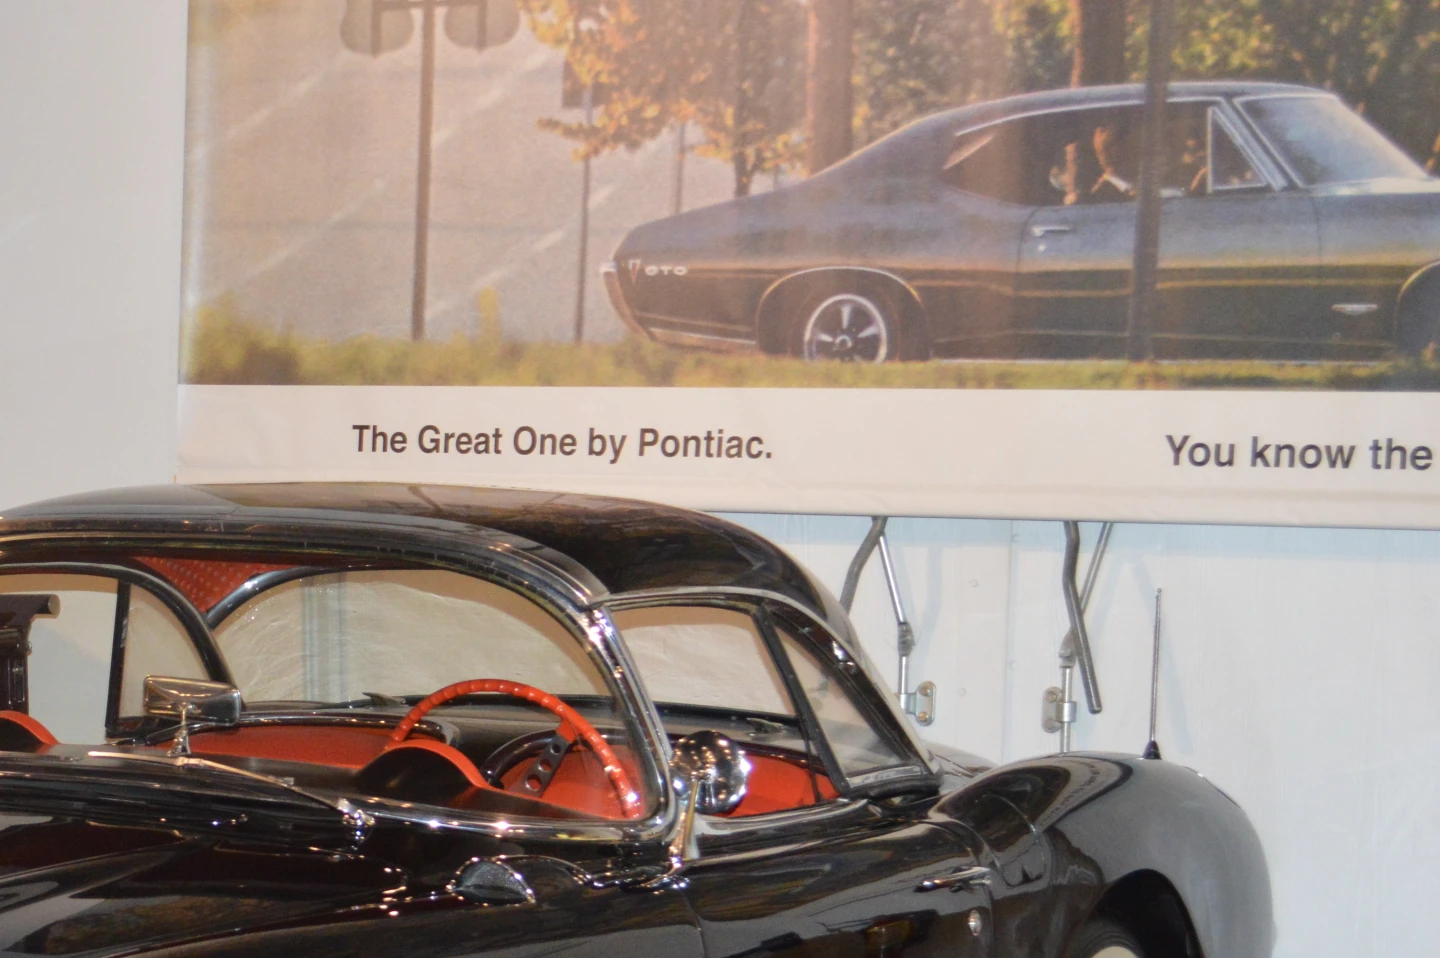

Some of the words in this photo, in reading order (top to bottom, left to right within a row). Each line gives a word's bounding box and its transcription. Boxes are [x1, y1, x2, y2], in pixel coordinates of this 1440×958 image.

[352, 424, 408, 453] The
[418, 424, 503, 455] Great
[513, 425, 577, 456] One
[588, 427, 627, 464] by
[638, 427, 773, 459] Pontiac.
[1165, 434, 1236, 467] You
[1250, 436, 1356, 469] know
[1369, 437, 1434, 471] the
